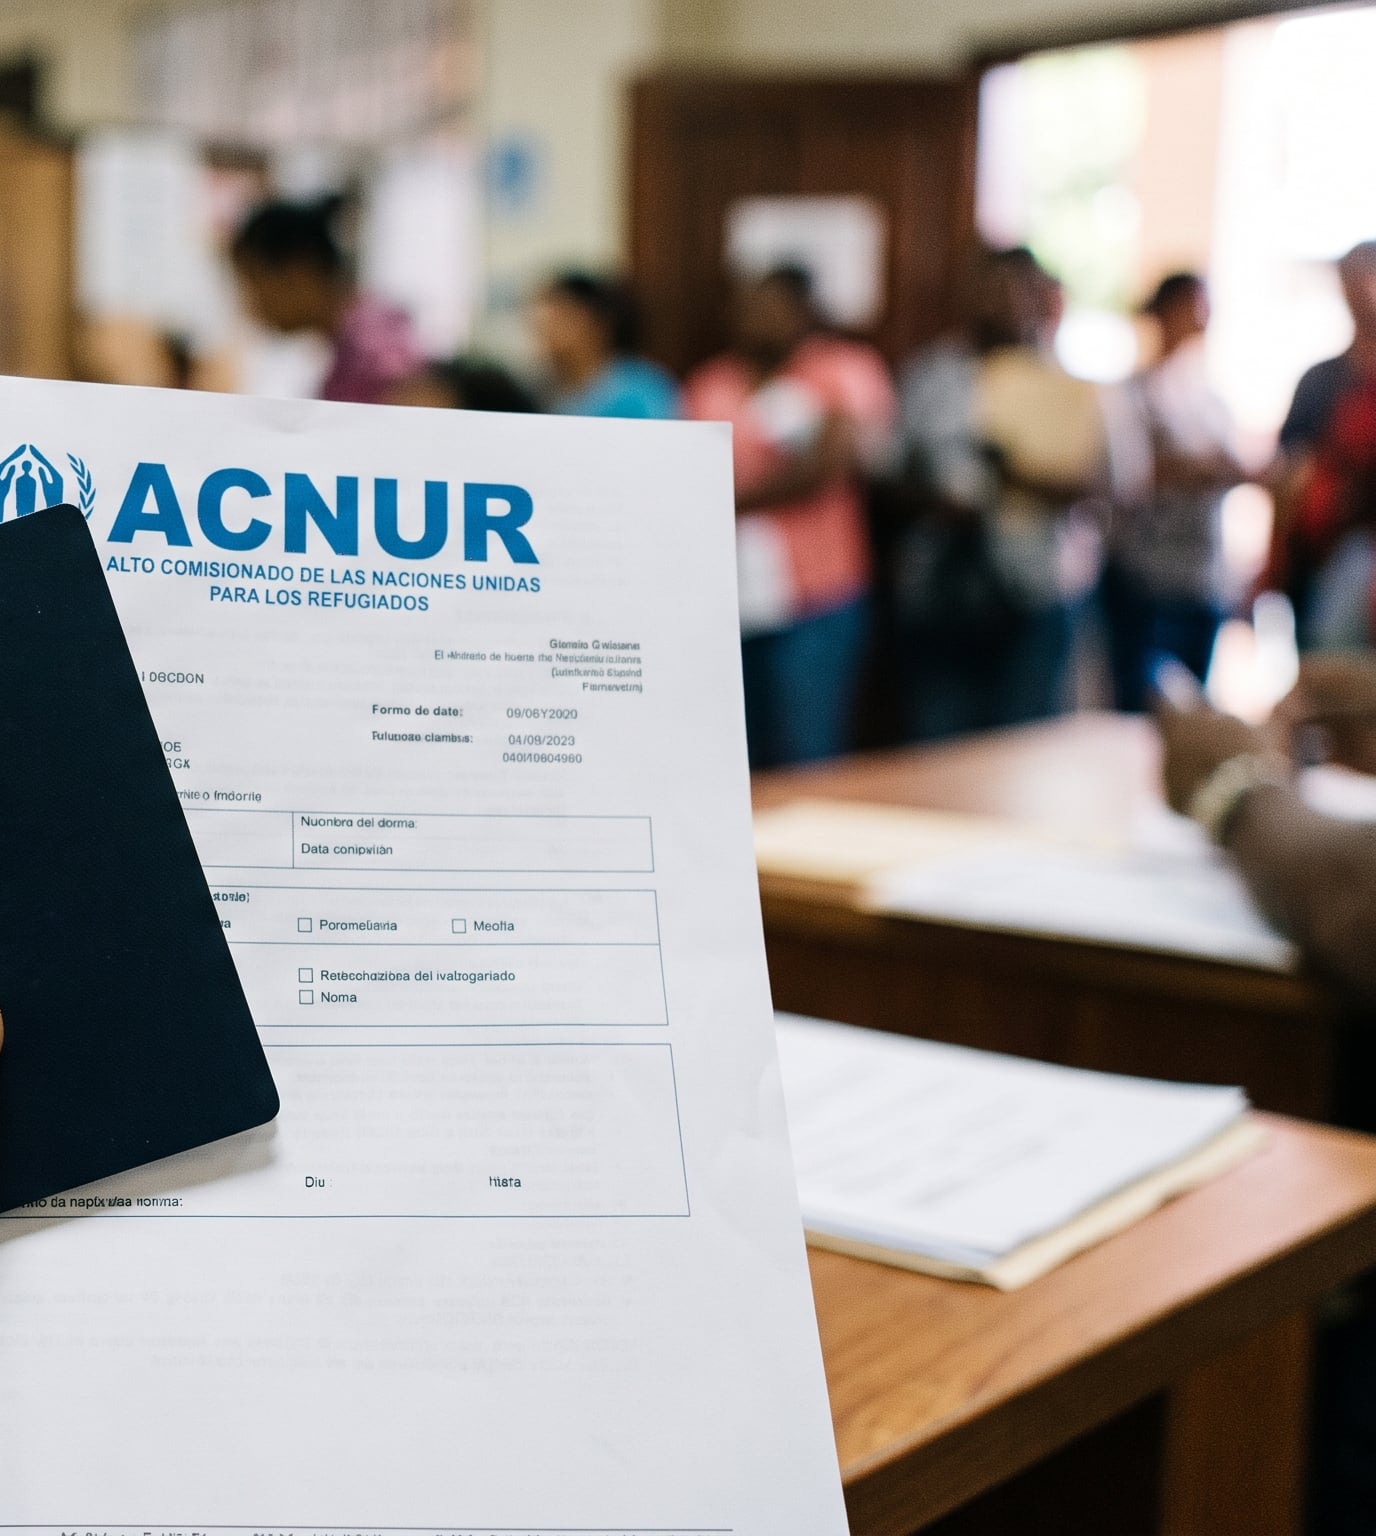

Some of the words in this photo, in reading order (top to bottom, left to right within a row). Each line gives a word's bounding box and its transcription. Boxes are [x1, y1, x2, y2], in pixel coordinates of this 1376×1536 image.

[107, 462, 540, 564] ACNUR
[106, 556, 155, 574] ALTO
[161, 559, 294, 582] COMISIONADO
[300, 567, 324, 584] DE
[330, 568, 366, 586] LAS
[371, 571, 467, 591] NACIONES
[472, 575, 541, 593] UNIDAS
[209, 586, 259, 603] PARA
[265, 588, 302, 606] LOS
[307, 591, 430, 612] REFUGIADOS
[356, 817, 375, 828] del
[301, 843, 329, 854] Data
[414, 970, 433, 982] del
[320, 992, 358, 1004] Noma
